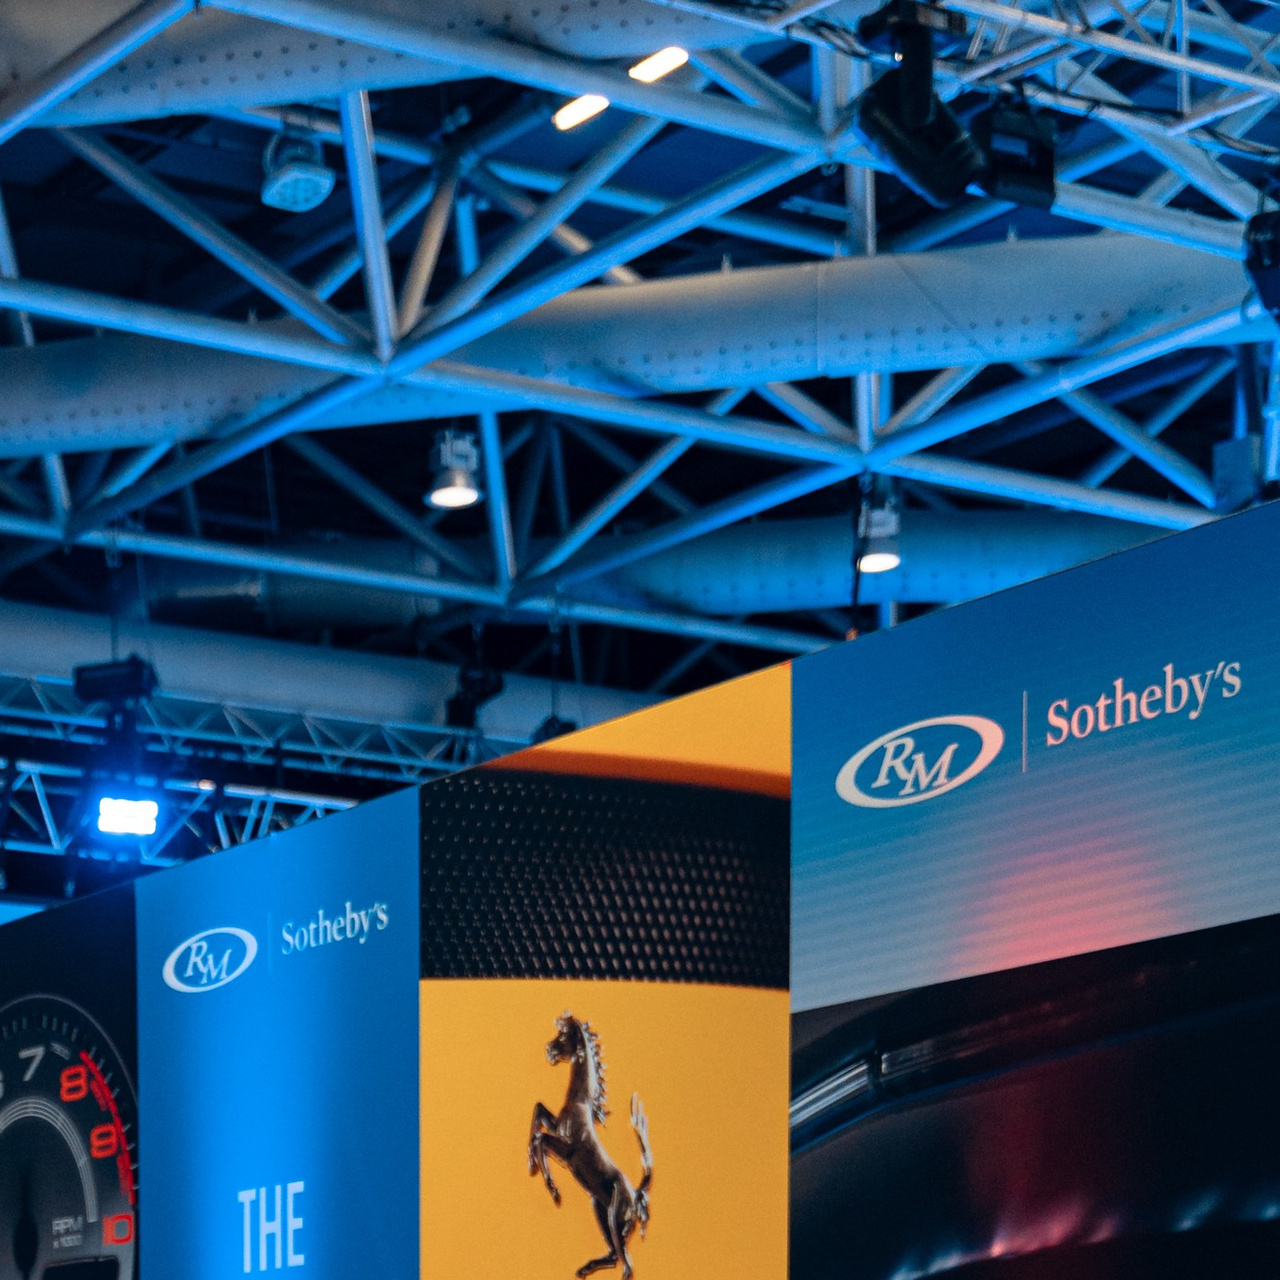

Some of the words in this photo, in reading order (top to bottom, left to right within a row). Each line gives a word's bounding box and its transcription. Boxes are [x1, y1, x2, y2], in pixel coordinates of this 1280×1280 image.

[871, 737, 959, 796] RM
[1045, 661, 1242, 746] Sotheby's
[185, 939, 234, 983] RM
[281, 902, 389, 955] Sotheby's
[18, 1046, 45, 1082] 7
[60, 1064, 88, 1102] 8
[238, 1181, 306, 1274] THE
